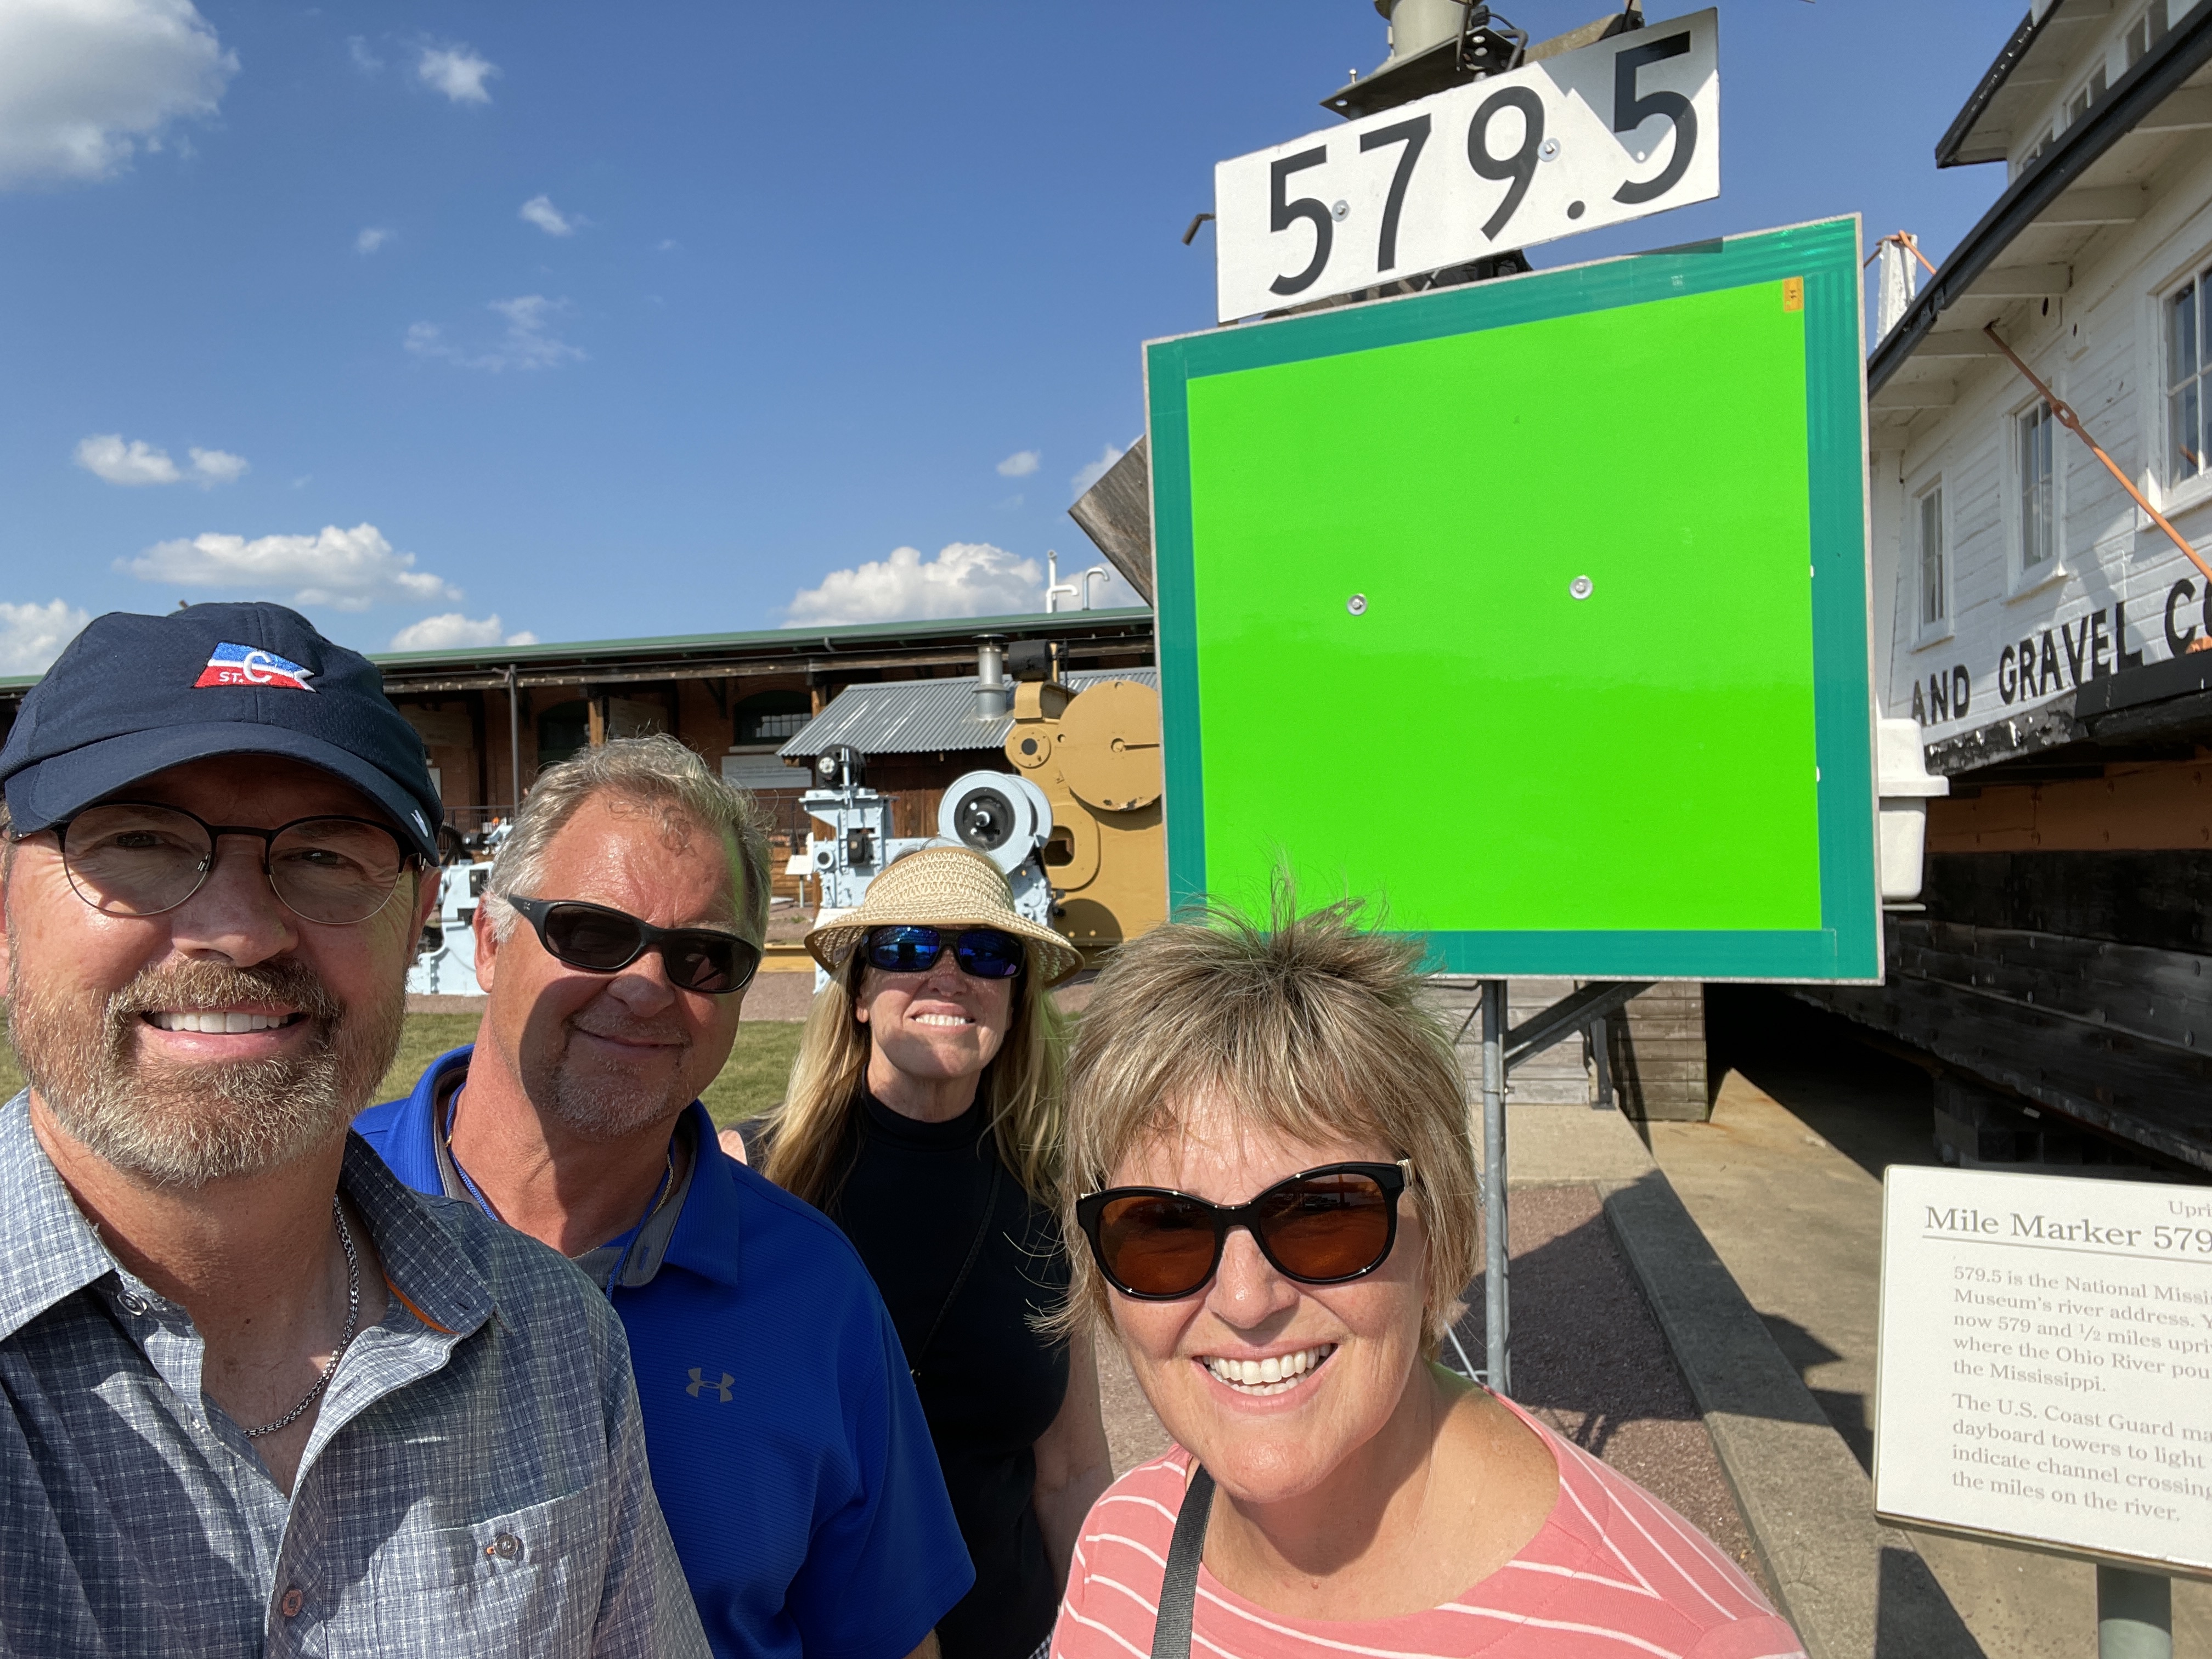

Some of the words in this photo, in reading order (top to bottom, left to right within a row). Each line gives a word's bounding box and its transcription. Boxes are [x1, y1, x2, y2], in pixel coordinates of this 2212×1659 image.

[1269, 31, 1697, 296] 579.5
[1912, 664, 1970, 727] AND
[1999, 602, 2143, 704] GRAVEL
[1924, 1205, 1999, 1234] Mile
[2010, 1212, 2142, 1246] Marker
[2153, 1225, 2212, 1253] 579
[1954, 1266, 2001, 1283] 579.5
[2008, 1270, 2022, 1285] is
[2028, 1272, 2058, 1289] the
[2065, 1276, 2147, 1298] National
[2153, 1285, 2212, 1305] Missi
[1954, 1288, 2051, 1311] Museum's
[2058, 1299, 2104, 1317] river
[2110, 1305, 2194, 1327] address.
[1954, 1315, 1991, 1328] now
[1998, 1316, 2030, 1333] 579
[2037, 1323, 2072, 1338] and
[2107, 1329, 2161, 1348] miles
[2168, 1338, 2212, 1354] upri
[1953, 1336, 2012, 1355] where
[2018, 1342, 2049, 1359] the
[2056, 1346, 2104, 1366] Ohio
[2111, 1352, 2165, 1373] River
[2171, 1364, 2209, 1379] pou
[1954, 1358, 1983, 1376] the
[1990, 1362, 2106, 1392] Mississippi.
[1951, 1392, 1990, 1412] The
[1996, 1398, 2036, 1419] U.S.
[2044, 1405, 2101, 1427] Coast
[2108, 1414, 2174, 1437] Guard
[2182, 1428, 2212, 1442] ma
[1953, 1418, 2045, 1445] dayboard
[2052, 1433, 2121, 1456] towers
[2128, 1444, 2147, 1460] to
[2154, 1445, 2205, 1469] light
[1953, 1443, 2030, 1470] indicate
[2036, 1457, 2119, 1483] channel
[1952, 1470, 1984, 1490] the
[1990, 1479, 2045, 1499] miles
[2051, 1490, 2076, 1504] on
[2084, 1491, 2117, 1511] the
[2124, 1498, 2180, 1521] river.
